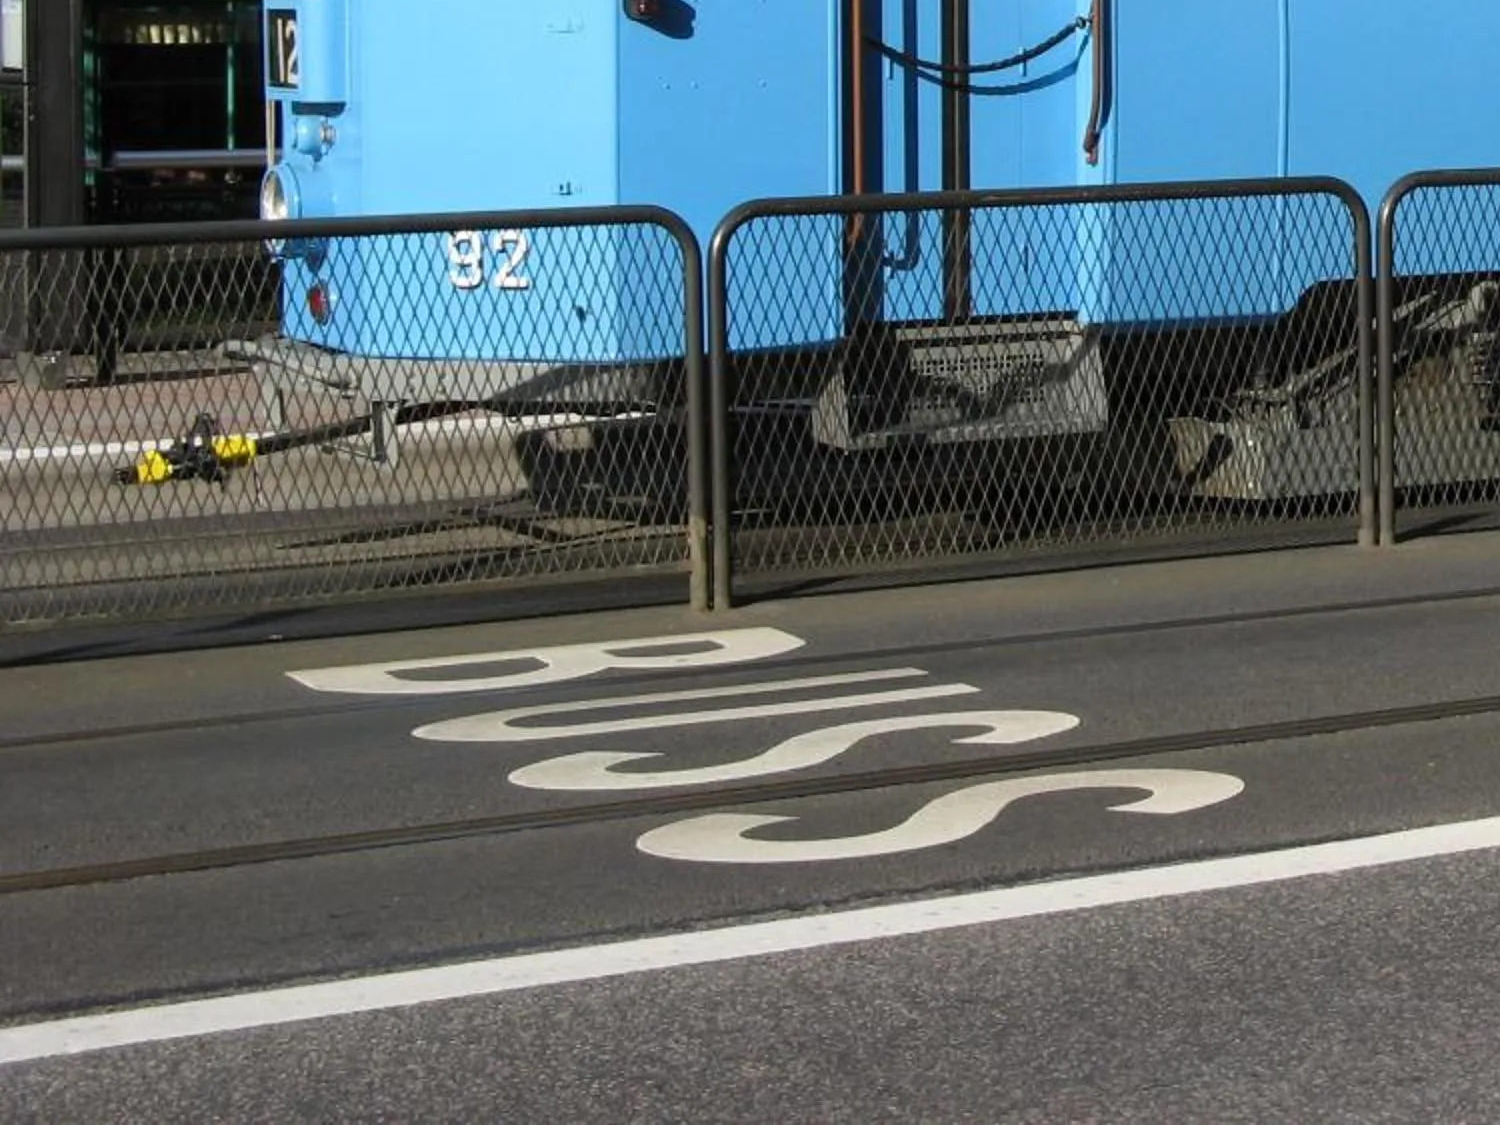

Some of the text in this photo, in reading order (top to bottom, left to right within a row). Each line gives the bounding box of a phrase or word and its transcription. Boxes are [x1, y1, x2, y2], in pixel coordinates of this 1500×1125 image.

[277, 18, 300, 84] 12
[448, 229, 529, 288] 92
[286, 627, 1245, 863] BUSS
